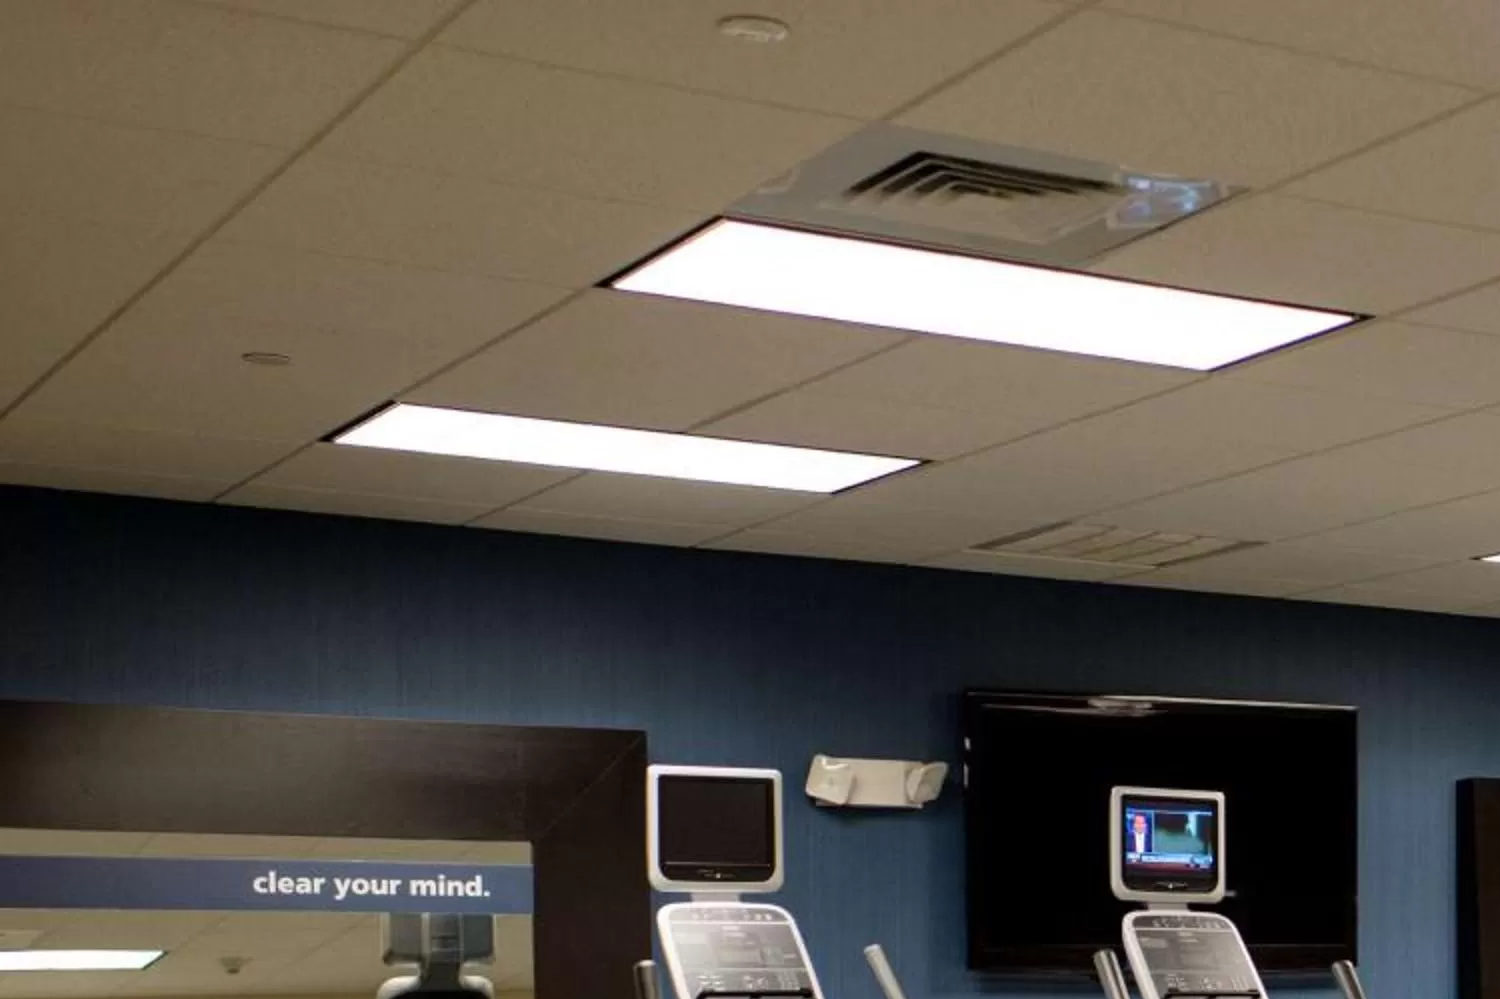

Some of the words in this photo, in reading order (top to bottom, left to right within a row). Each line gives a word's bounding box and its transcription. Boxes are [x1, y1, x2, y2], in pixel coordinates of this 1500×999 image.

[252, 870, 326, 895] clear
[333, 876, 402, 900] your
[409, 874, 491, 898] mind.
